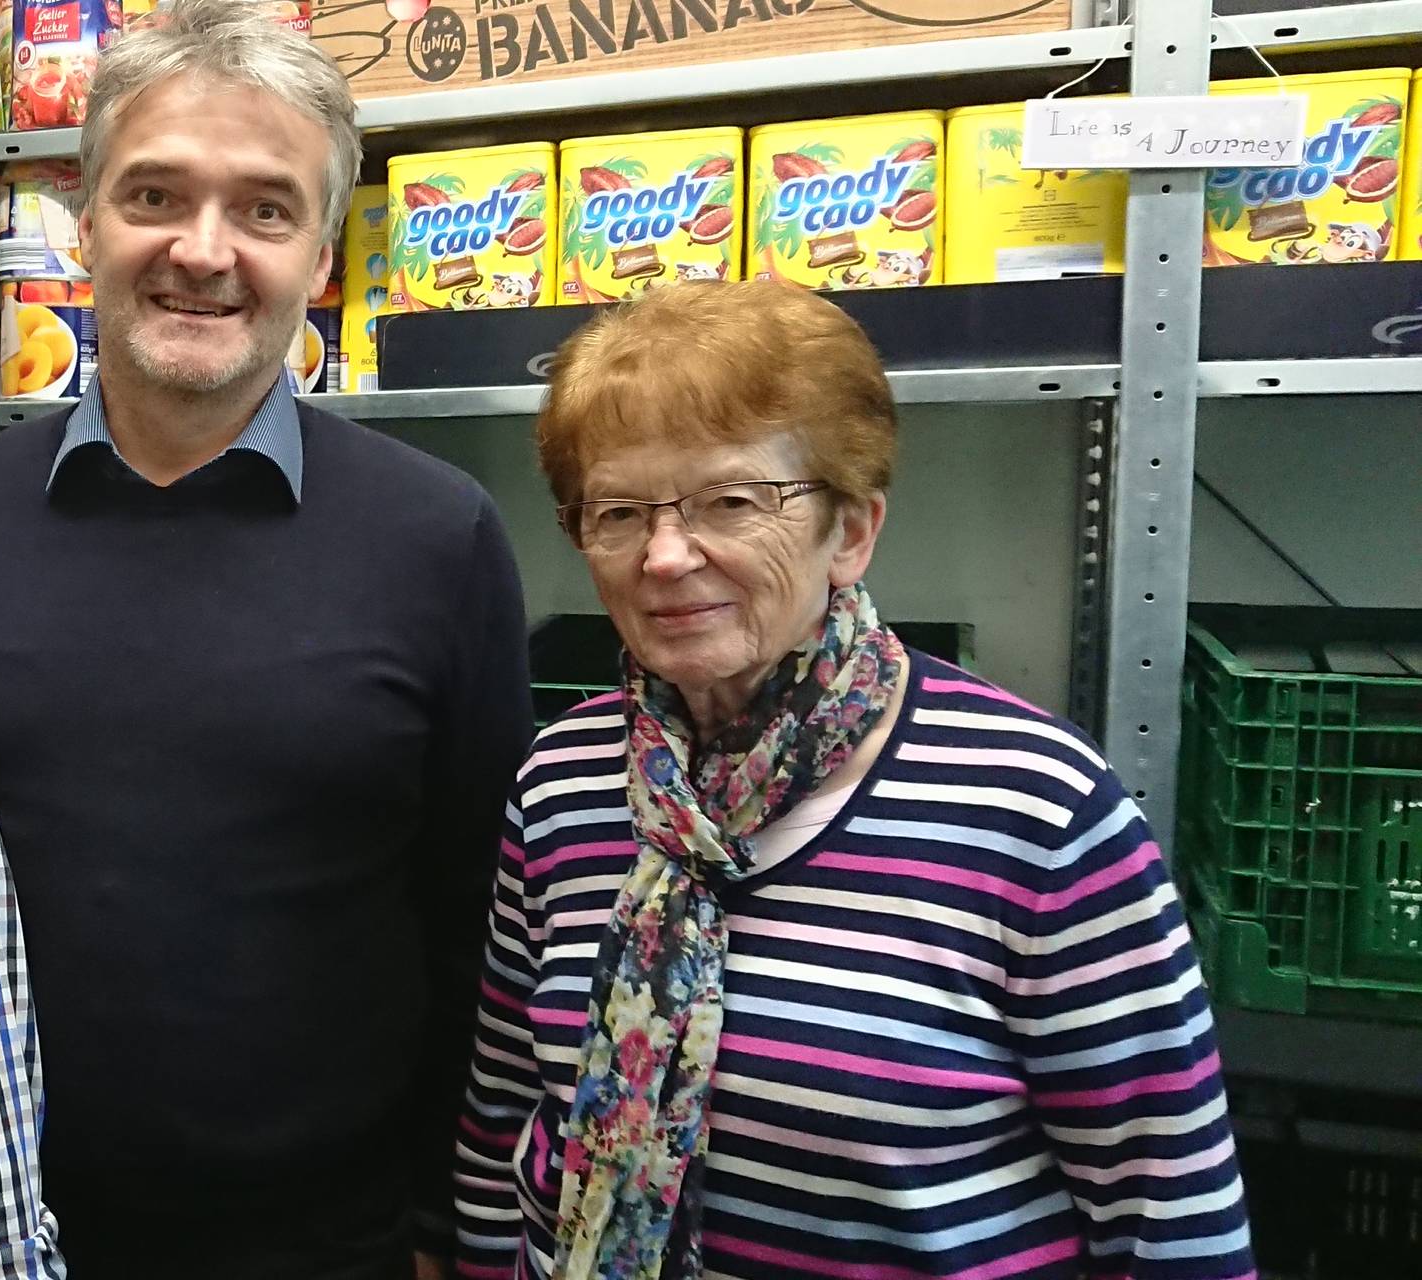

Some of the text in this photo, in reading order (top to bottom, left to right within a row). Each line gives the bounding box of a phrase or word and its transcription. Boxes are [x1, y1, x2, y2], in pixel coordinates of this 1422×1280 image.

[33, 21, 69, 35] Zucker
[414, 35, 461, 54] LUNITA
[477, 0, 816, 80] BANAN
[1050, 110, 1293, 161] Life is A Journey
[777, 159, 912, 218] goody
[1244, 165, 1330, 202] cao
[408, 189, 522, 243] goody
[584, 175, 709, 230] goody
[804, 198, 876, 232] cao
[430, 226, 492, 257] cao
[608, 213, 676, 244] cao
